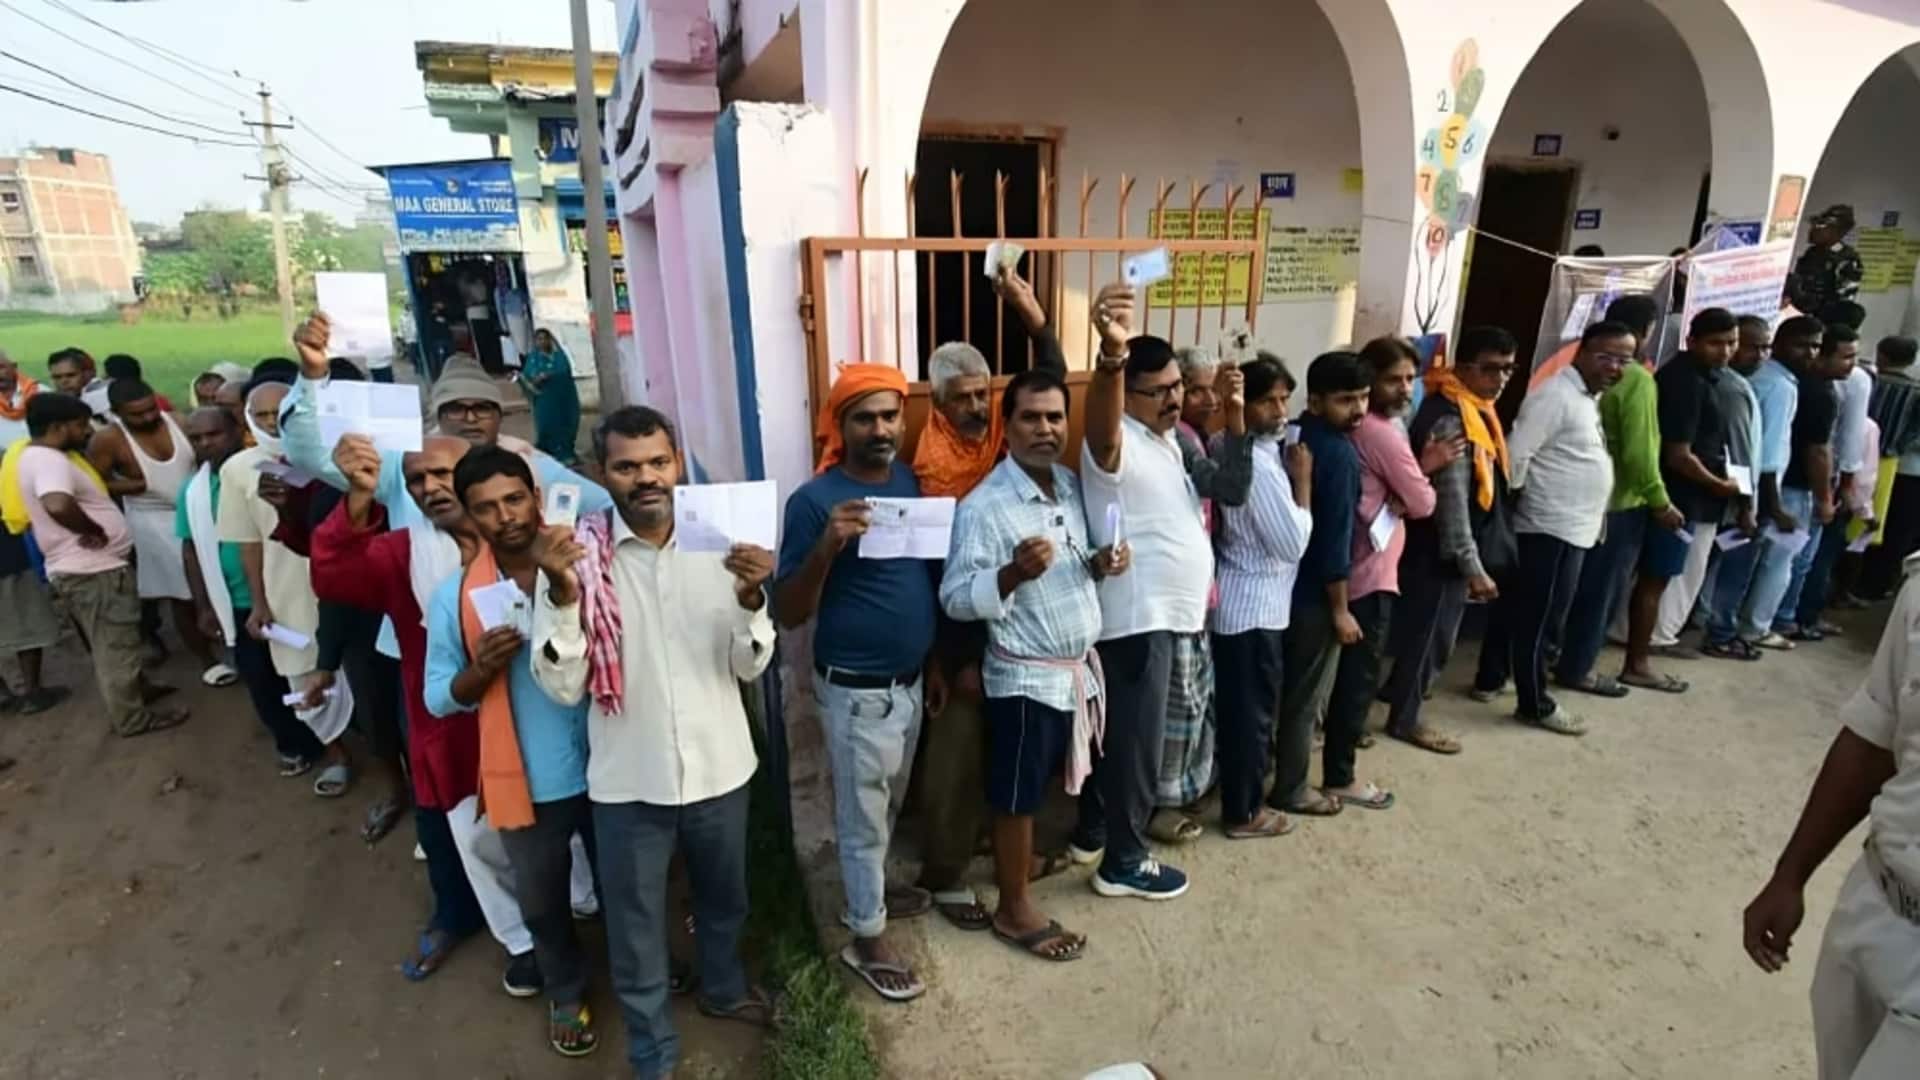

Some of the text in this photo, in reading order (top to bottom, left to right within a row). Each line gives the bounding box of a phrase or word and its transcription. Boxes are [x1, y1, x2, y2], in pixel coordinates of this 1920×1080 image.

[1436, 88, 1449, 112] 2
[1422, 125, 1476, 160] 4 5 6
[1419, 171, 1432, 193] 7
[394, 195, 516, 214] MAA GENERAL STORE
[1425, 226, 1445, 247] 10
